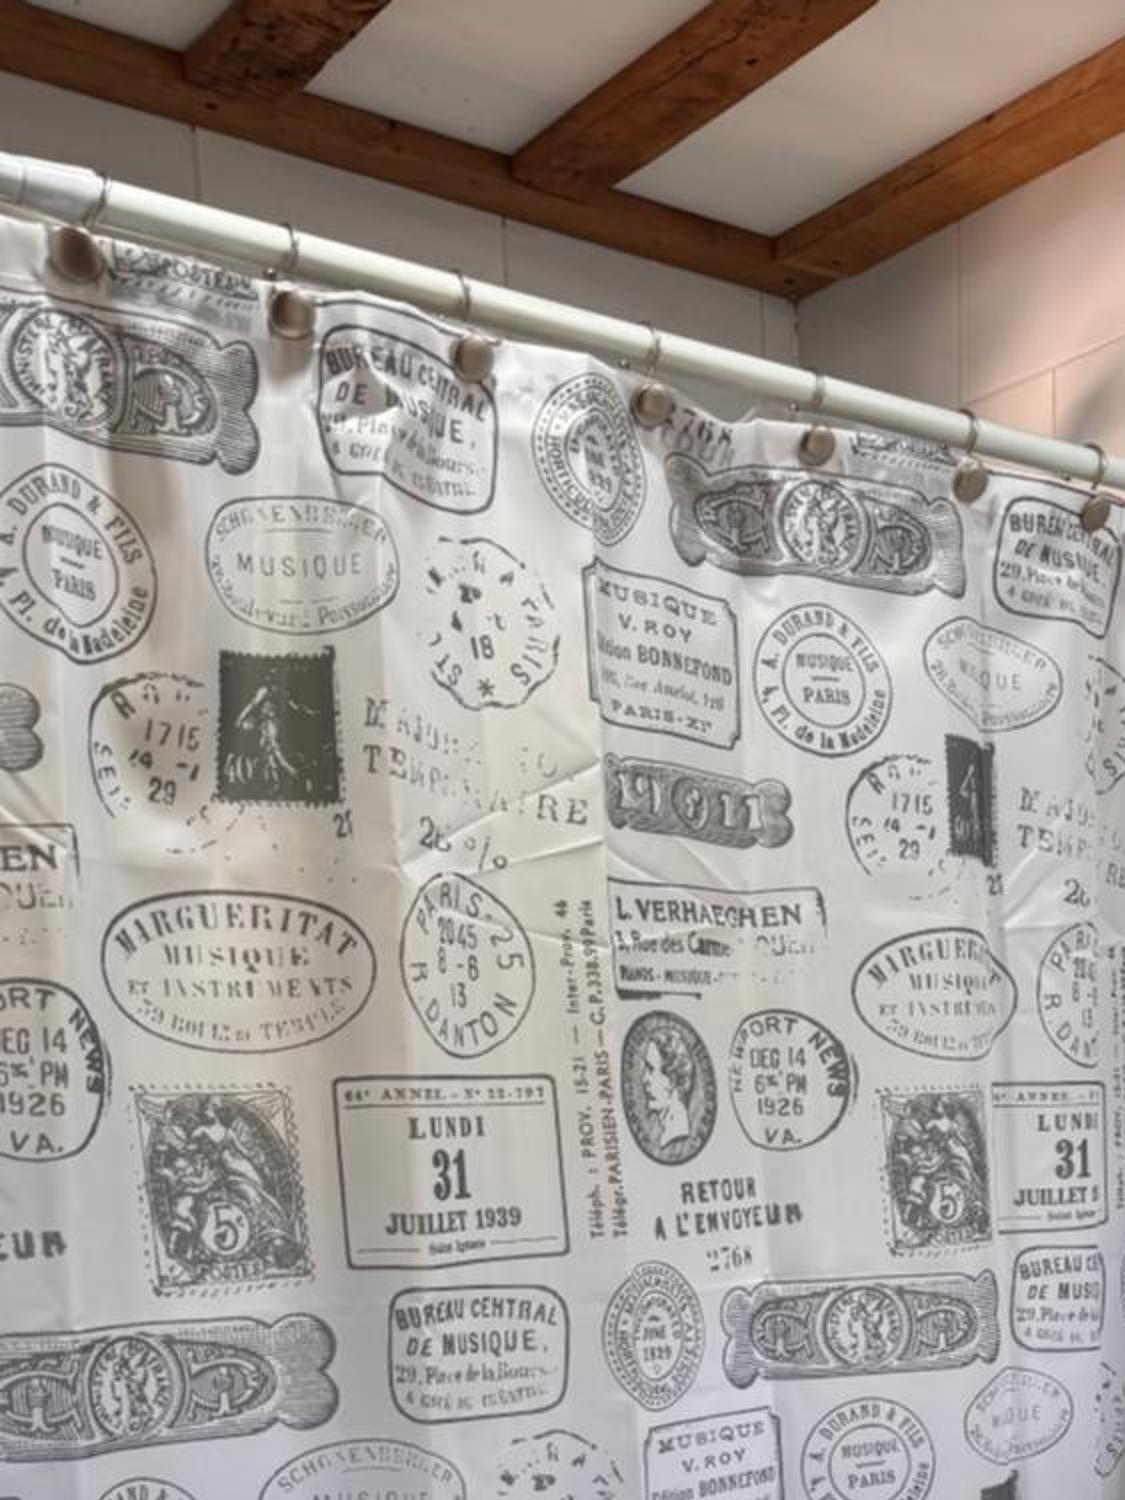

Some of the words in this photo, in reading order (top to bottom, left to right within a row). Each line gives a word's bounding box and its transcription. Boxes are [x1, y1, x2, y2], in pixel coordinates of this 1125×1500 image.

[13, 472, 83, 515] DURAND
[237, 552, 361, 576] MUSIQUE
[52, 567, 97, 602] PARIS
[643, 622, 693, 644] ROY
[772, 609, 836, 645] DURAND
[851, 637, 880, 674] FILS
[472, 635, 495, 659] 18
[637, 644, 733, 686] BONNEFOND
[796, 652, 855, 674] MUSIQUE
[803, 685, 852, 707] PARIS
[635, 897, 802, 929] VERHAEGHEN
[42, 1025, 67, 1052] 14
[787, 1046, 806, 1067] 14
[757, 1096, 805, 1116] 1926
[408, 1115, 486, 1140] LUNDI
[1054, 1138, 1093, 1179] 31
[431, 1148, 471, 1202] 31
[680, 1176, 757, 1205] RETOUR
[385, 1209, 467, 1236] JUILLET
[475, 1206, 523, 1231] 1939
[654, 1215, 667, 1241] A
[675, 1203, 803, 1238] L'ENVOYEUR
[1027, 1284, 1049, 1299] DE
[394, 1298, 465, 1331] BUREAU
[470, 1296, 558, 1326] CENTRAL
[405, 1337, 433, 1357] DE
[657, 1421, 766, 1455] MUSIQUE
[819, 1403, 881, 1442] DURAND
[899, 1416, 925, 1451] FILS
[703, 1448, 746, 1468] ROY
[840, 1437, 898, 1459] MUSIQUE
[847, 1468, 896, 1489] PARIS
